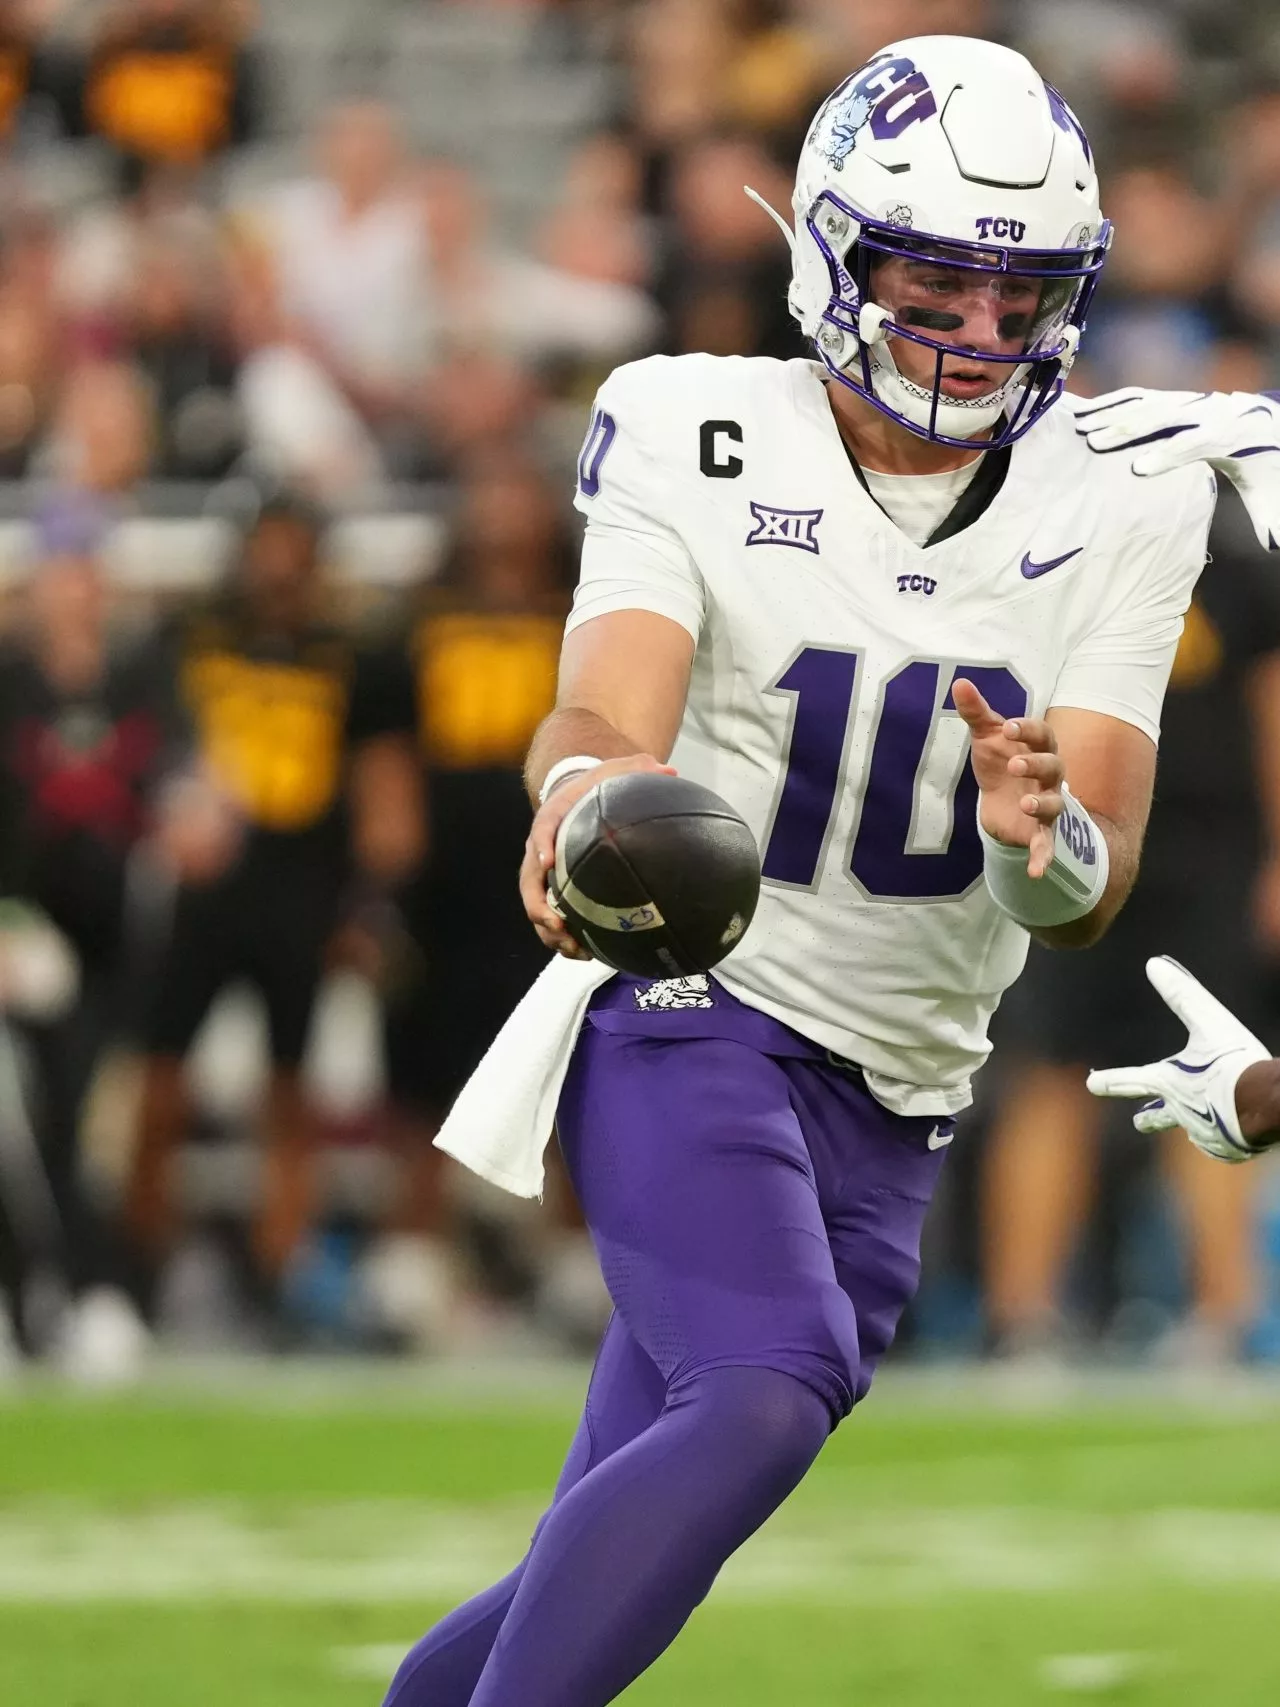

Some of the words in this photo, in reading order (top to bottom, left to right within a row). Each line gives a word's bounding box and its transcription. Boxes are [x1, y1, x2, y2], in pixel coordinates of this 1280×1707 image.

[975, 216, 1026, 243] TCU
[699, 419, 744, 479] C
[746, 501, 823, 554] XII
[896, 573, 938, 596] TCU
[758, 640, 1034, 905] 10
